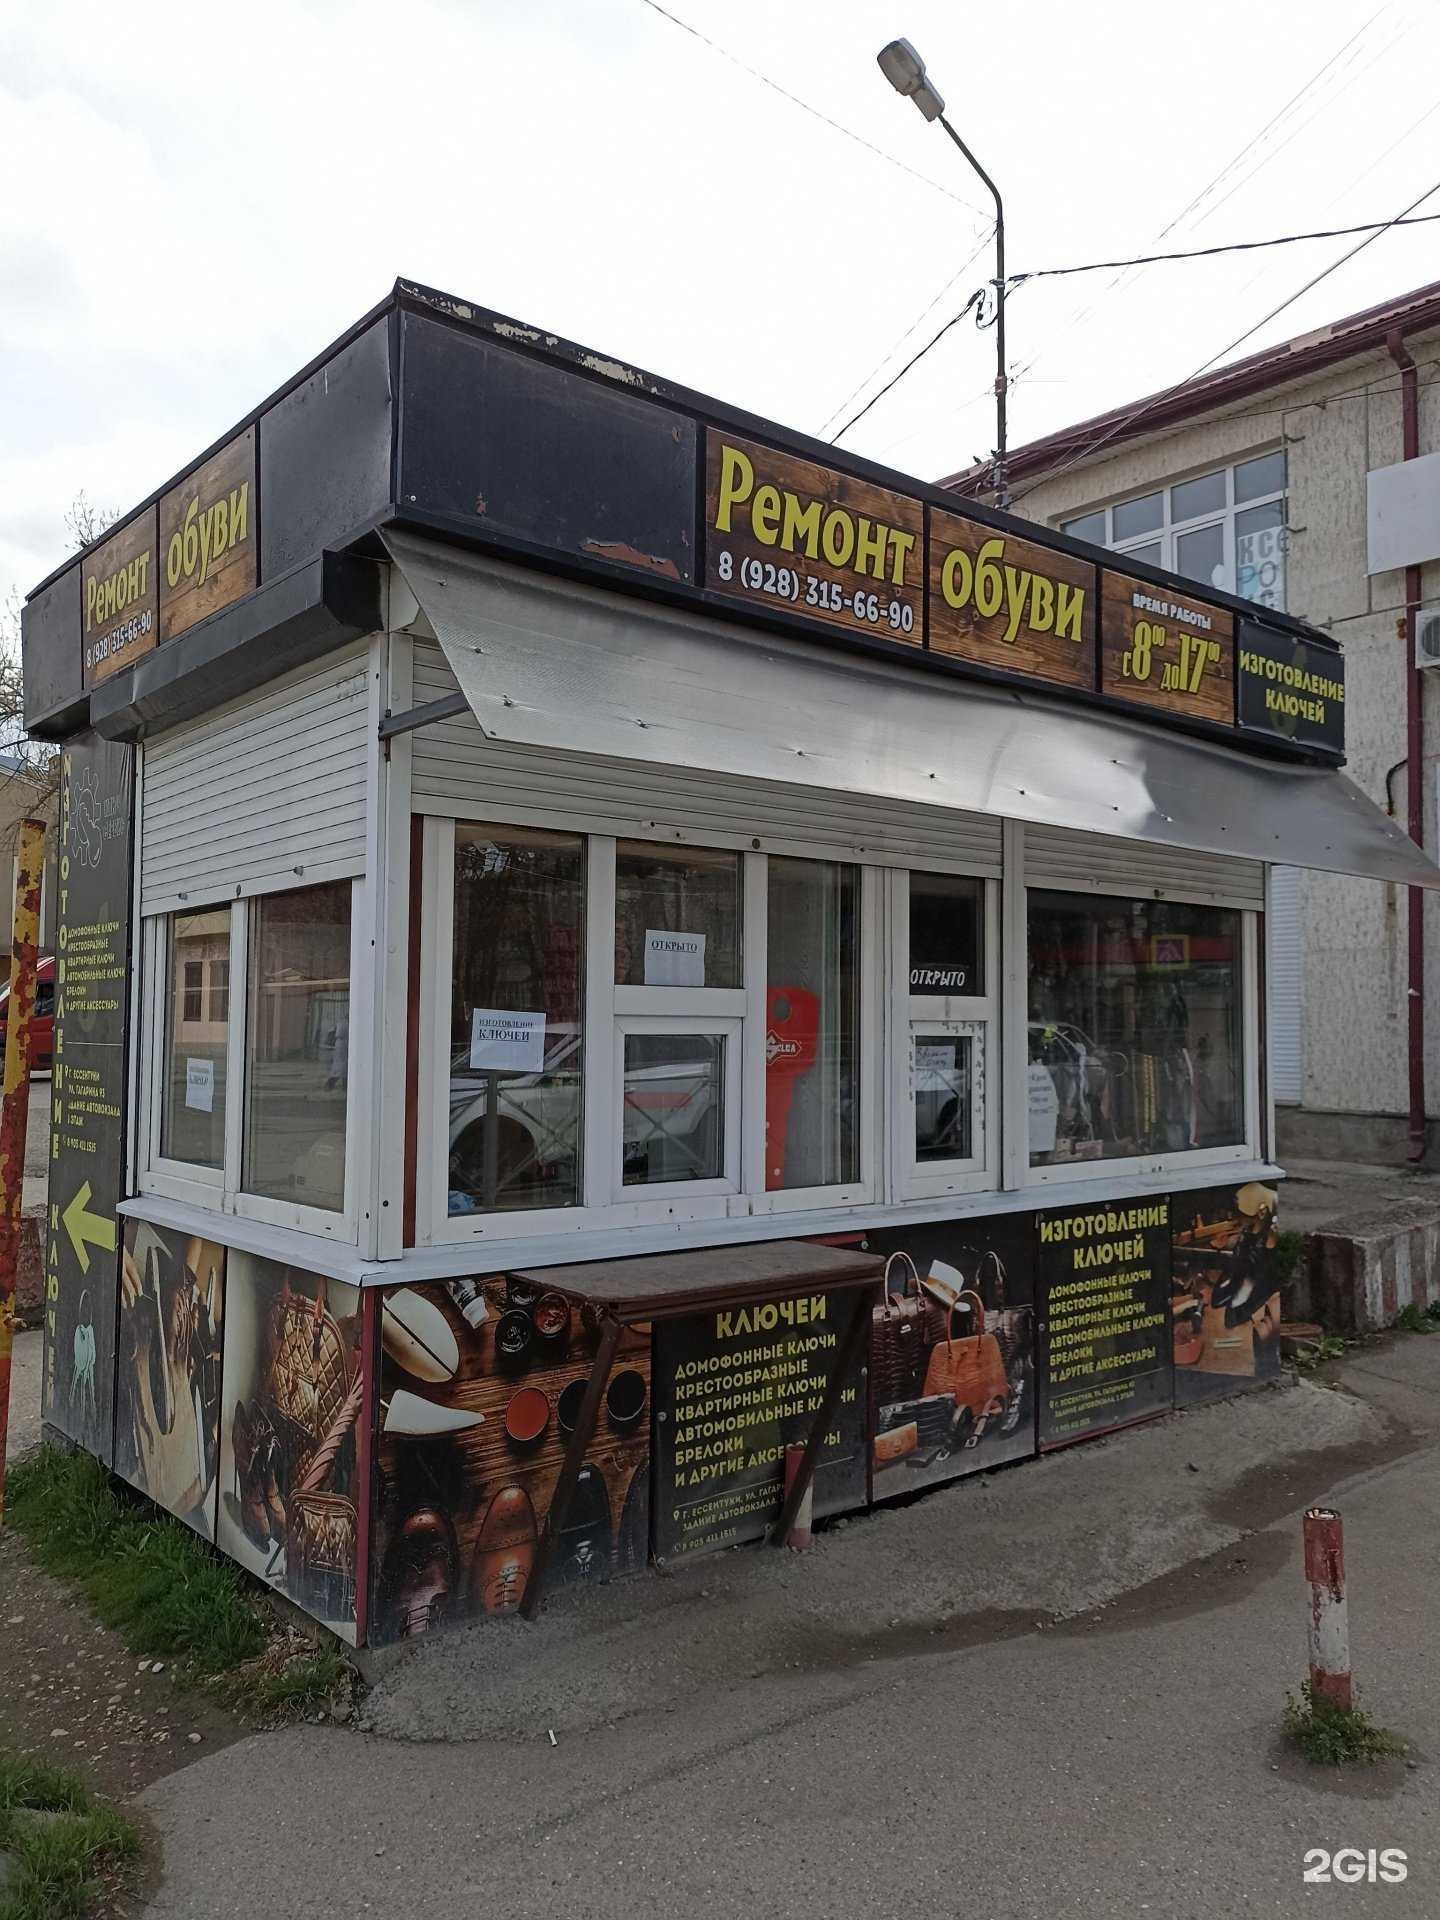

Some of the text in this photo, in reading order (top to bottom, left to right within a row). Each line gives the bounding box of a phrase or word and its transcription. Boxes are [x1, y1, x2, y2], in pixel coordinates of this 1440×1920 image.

[86, 481, 249, 633] Ремонт обуви
[716, 445, 1085, 642] Ремонт обуви
[718, 551, 914, 632] 8 (928) 315-66-90
[1132, 593, 1212, 630] ВРЕМЯ РАБОТЫ
[111, 610, 152, 653] 315-66-90
[1239, 650, 1344, 702] ИЗГОТОВЛЕНИЕ
[1265, 689, 1325, 725] КЛЮЧЕЙ
[651, 940, 698, 952] ОТКРЫТО
[910, 969, 965, 986] ОТКРЫТО
[480, 1028, 530, 1041] КЛЮЧЕЙ
[1041, 1205, 1168, 1243] ИЗГОТОВЛЕНИЕ
[1074, 1235, 1145, 1270] КЛЮЧЕЙ
[1048, 1269, 1152, 1299] ДОМОФОННЫЕ КЛЮЧИ
[1049, 1289, 1133, 1315] КРЕСТООБРАЗНЫЕ
[716, 1294, 826, 1339] КЛЮЧЕЙ
[1049, 1302, 1145, 1332] КВАРТИРНЫЕ КЛЮЧИ
[1049, 1313, 1165, 1350] АВТОМОБИЛЬНЫЕ КЛЮЧИ
[675, 1333, 836, 1380] ДОМОФОННЫЕ КЛЮЧИ
[1049, 1349, 1093, 1367] БРЕЛОКИ
[1050, 1346, 1156, 1383] И ДРУГИЕ АКСЕССУАРЫ
[676, 1359, 809, 1400] КРЕСТООБРАЗНЫЕ
[674, 1388, 855, 1444] АВТОМОБИЛЬНЫЕ КЛЧИ
[675, 1375, 827, 1422] КВАРТИРНЫЕ КЛЮЧИ
[675, 1435, 743, 1466] БРЕЛОКИ
[675, 1473, 685, 1488] И
[689, 1458, 744, 1485] ДРУГИЕ
[683, 1513, 716, 1532] ЗДАНИЕ
